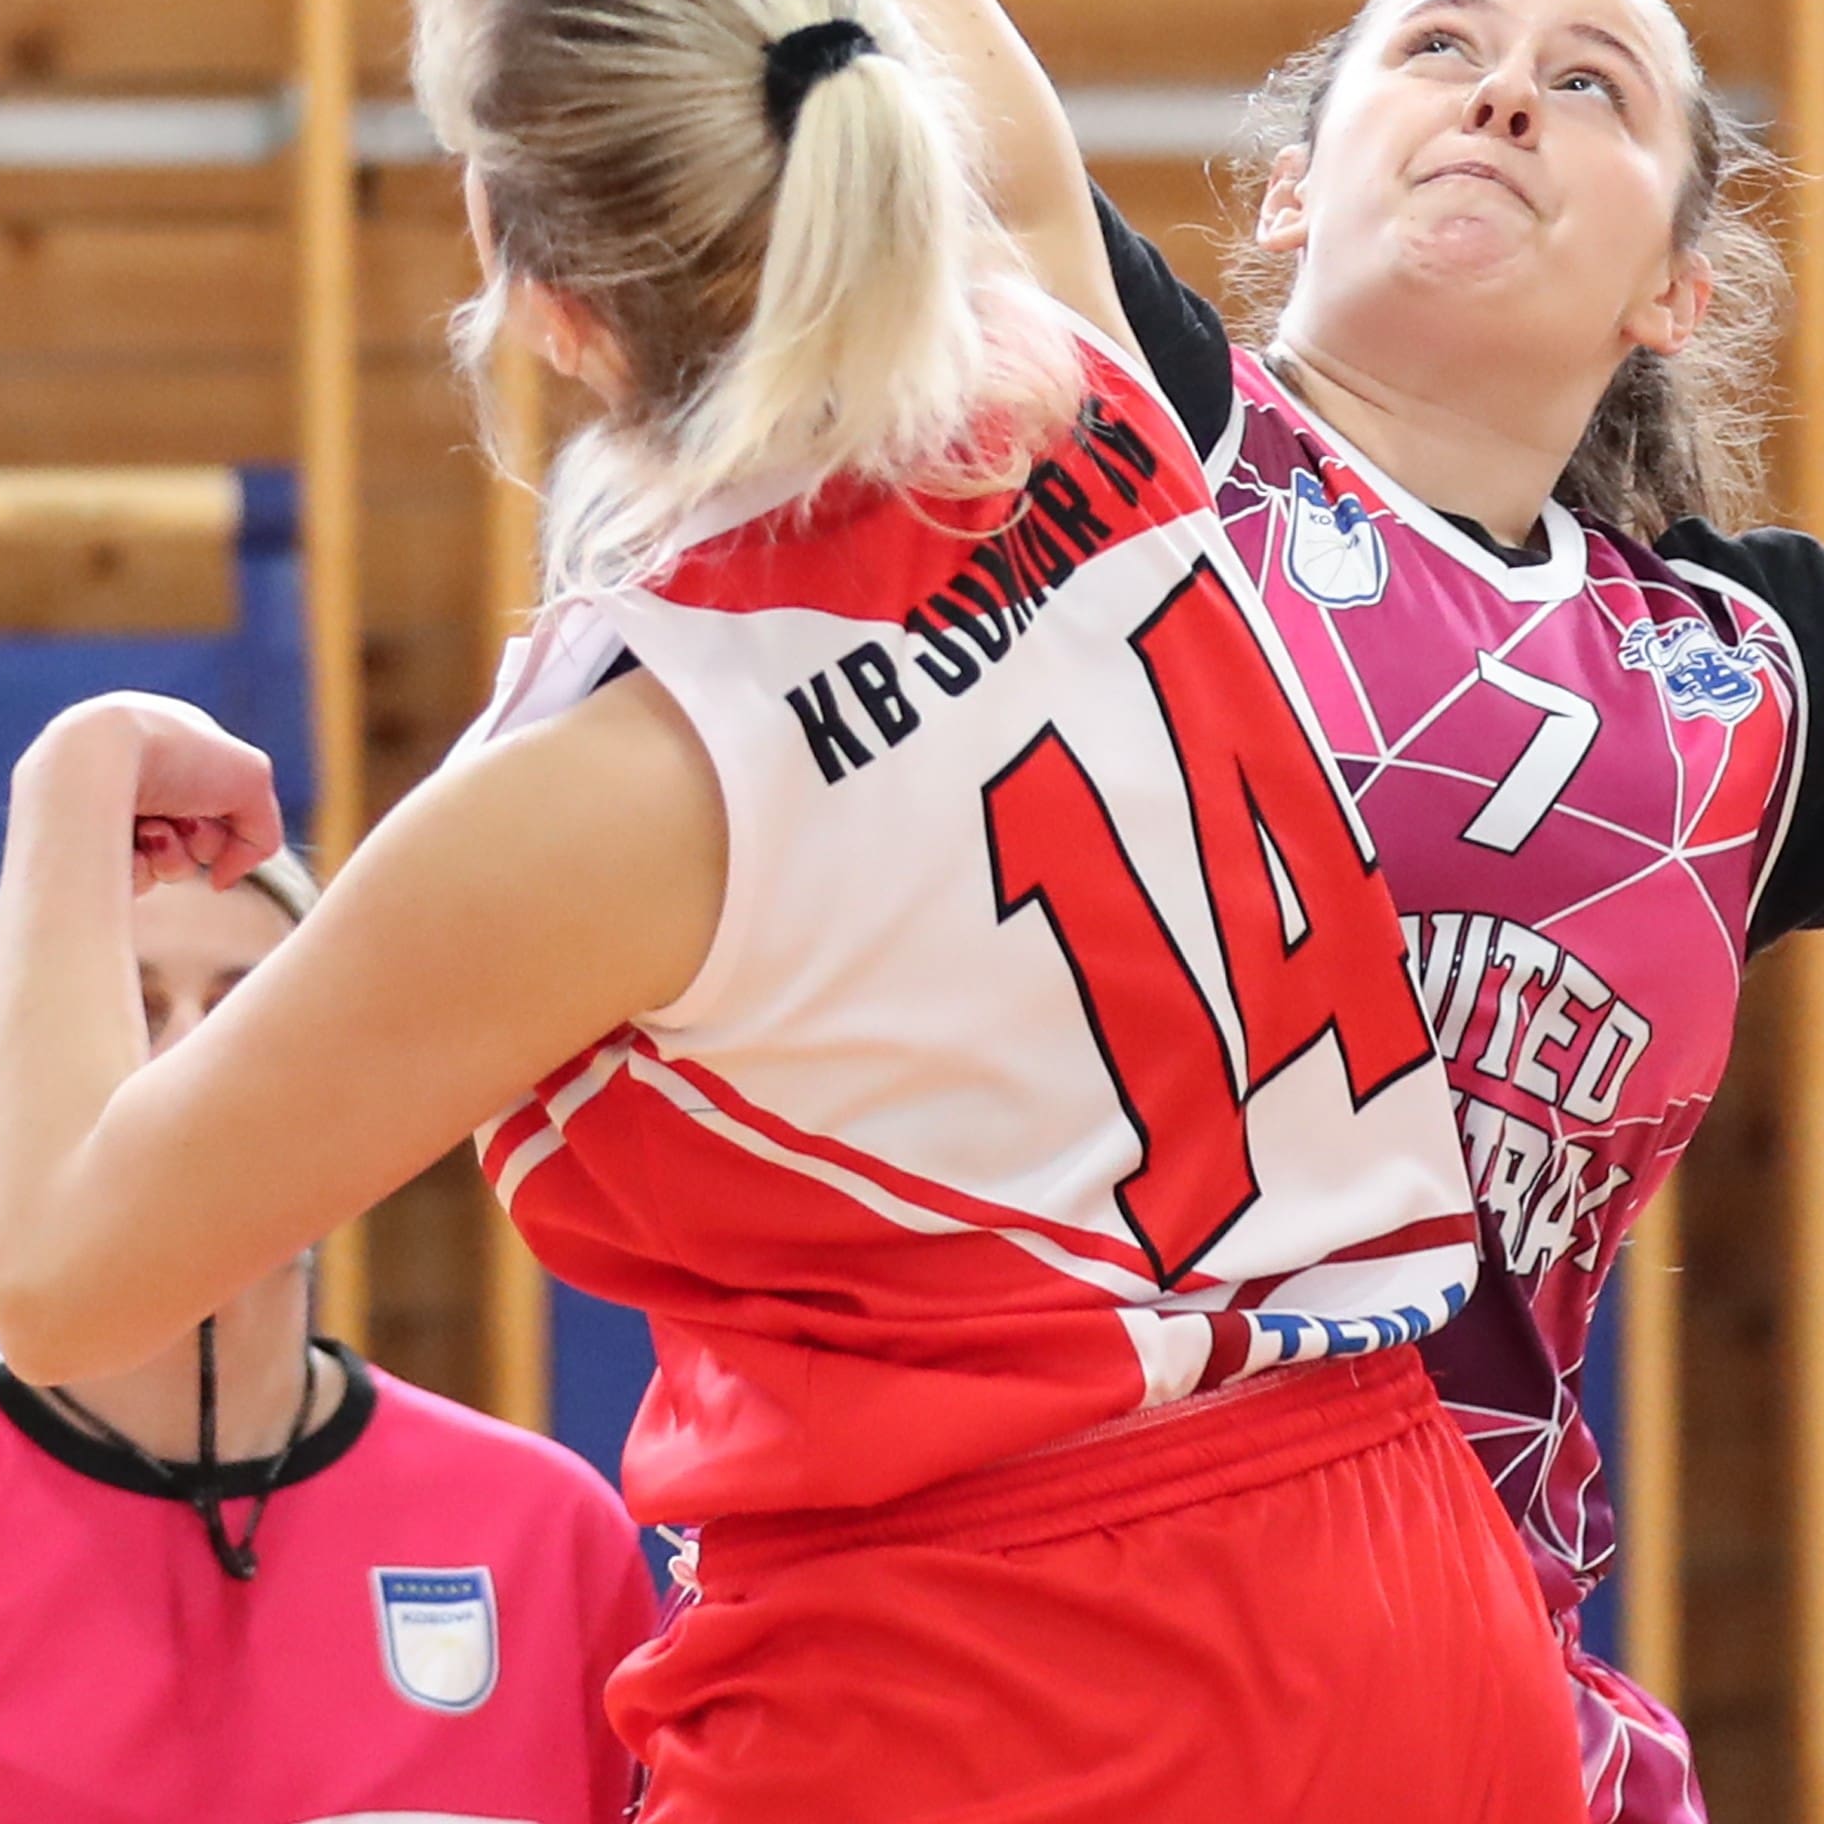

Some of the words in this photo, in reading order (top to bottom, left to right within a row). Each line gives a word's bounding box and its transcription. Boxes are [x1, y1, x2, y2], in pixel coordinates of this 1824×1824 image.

[784, 639, 922, 786] KB
[1457, 647, 1603, 857] 7
[981, 552, 1437, 1292] 14
[1399, 910, 1653, 1125] NITED
